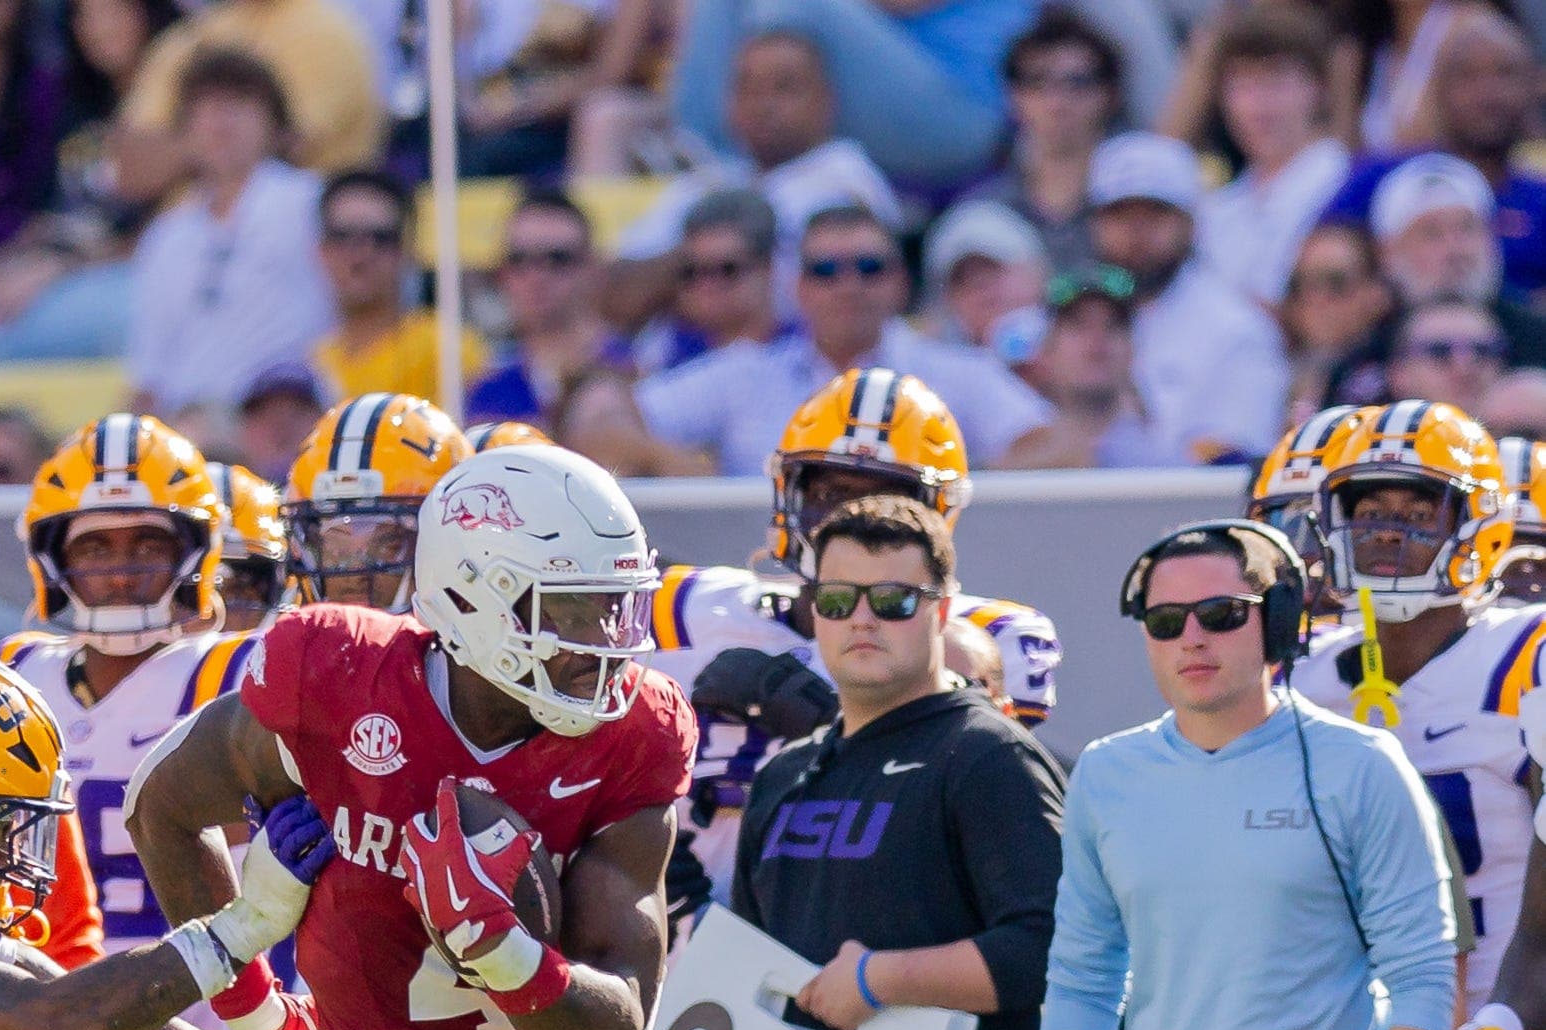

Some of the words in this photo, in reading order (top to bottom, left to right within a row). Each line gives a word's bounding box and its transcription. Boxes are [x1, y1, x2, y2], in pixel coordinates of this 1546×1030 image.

[614, 558, 638, 570] HOGS
[356, 717, 397, 758] SEC
[1243, 808, 1310, 830] LSU
